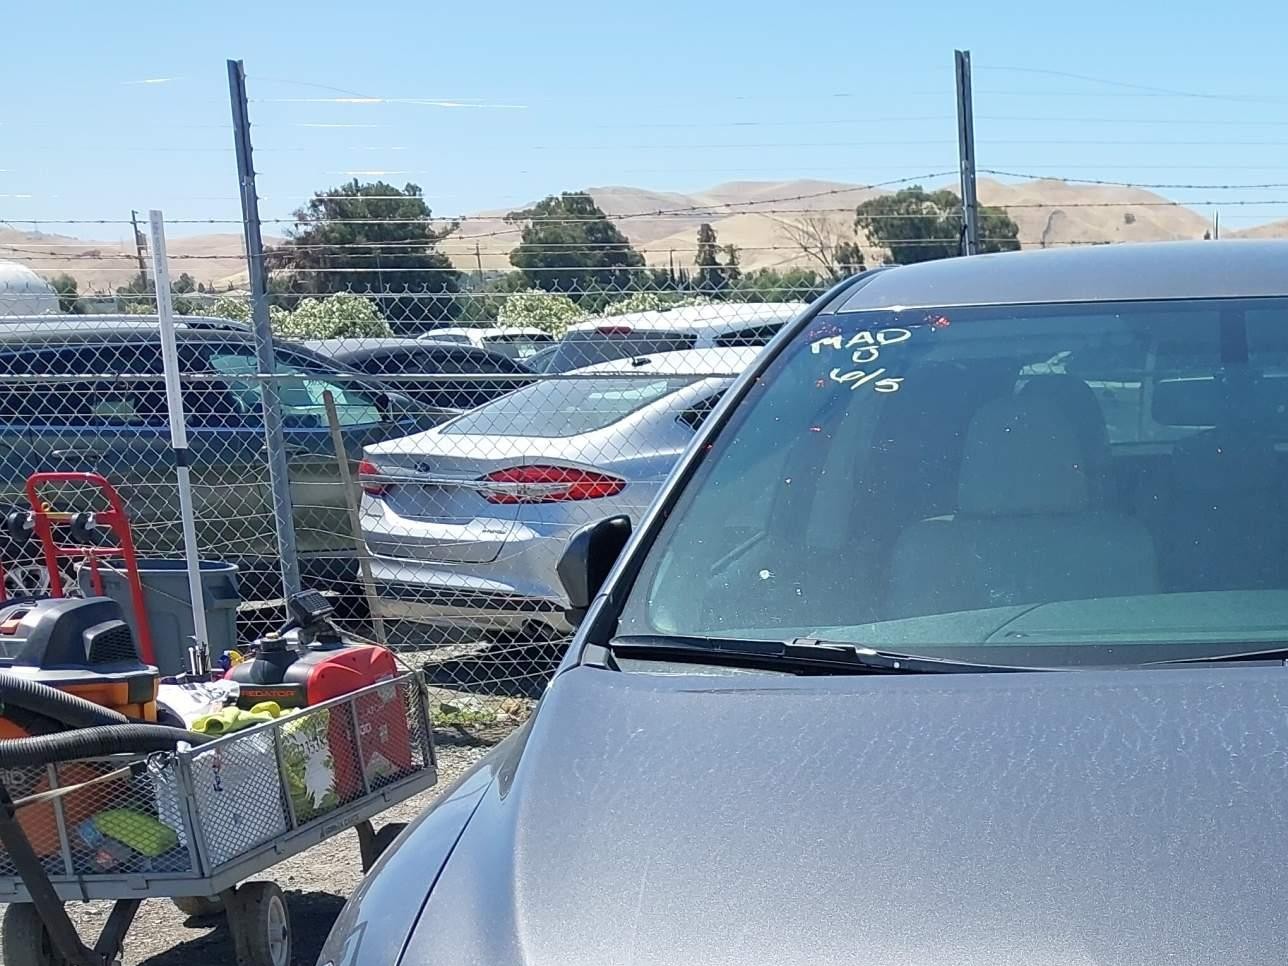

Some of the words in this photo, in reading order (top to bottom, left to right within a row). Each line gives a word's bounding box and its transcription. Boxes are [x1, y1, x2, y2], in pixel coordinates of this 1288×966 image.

[811, 328, 912, 354] MAD
[829, 368, 905, 393] 6/5
[240, 690, 297, 698] REDATOR
